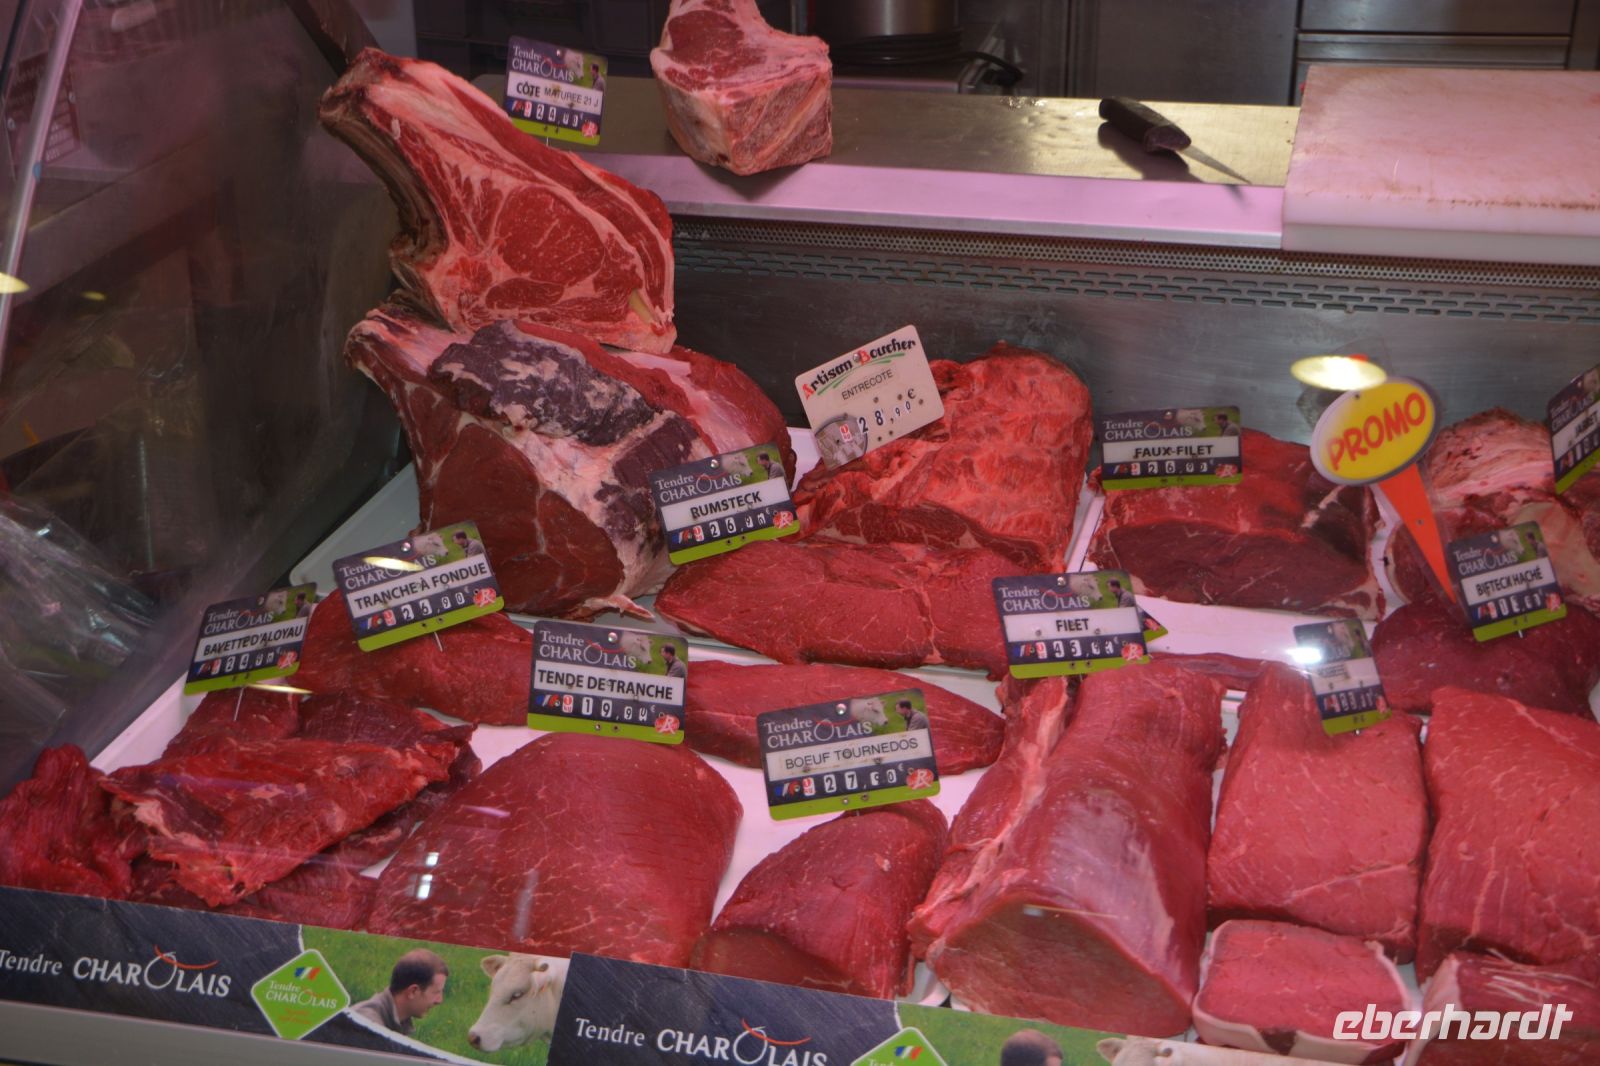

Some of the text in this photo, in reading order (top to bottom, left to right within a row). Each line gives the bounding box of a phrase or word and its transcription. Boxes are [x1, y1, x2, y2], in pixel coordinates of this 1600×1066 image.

[513, 46, 542, 60] Tendre
[512, 57, 574, 81] CHAROLAIS
[516, 82, 541, 98] CÔTE
[802, 338, 916, 399] Artisan Boucher
[841, 369, 894, 400] ENTRECOTE
[1102, 419, 1144, 430] Tendre
[1104, 421, 1193, 440] CHAROLAIS
[1326, 391, 1426, 471] PROMO
[1134, 445, 1214, 458] FAUX-FILET
[654, 473, 695, 490] Tendre
[659, 473, 742, 503] CHAROLAIS
[690, 490, 762, 519] RUMSTECK
[1458, 548, 1519, 576] CHAROLAIS
[354, 562, 488, 610] TRANCHE À FONDUE
[999, 586, 1041, 599] Tendre
[1003, 589, 1091, 612] CHAROLAIS
[204, 609, 274, 635] CHAROLAIS
[1055, 618, 1090, 632] FILET
[203, 624, 304, 656] BAVETTE D'ALOYAU
[539, 630, 585, 646] Tendre
[539, 642, 637, 669] CHAROLAIS
[538, 669, 673, 700] TENDE DE TRANCHE
[764, 717, 813, 734] Tendre
[767, 718, 873, 749] CHAROLAIS
[785, 737, 919, 770] BOEUF TOURNEDOS
[0, 949, 232, 998] Tendre CHAROLAIS
[266, 989, 337, 1009] CHAROLAIS
[575, 1017, 828, 1066] Tendre CHAROLAIS
